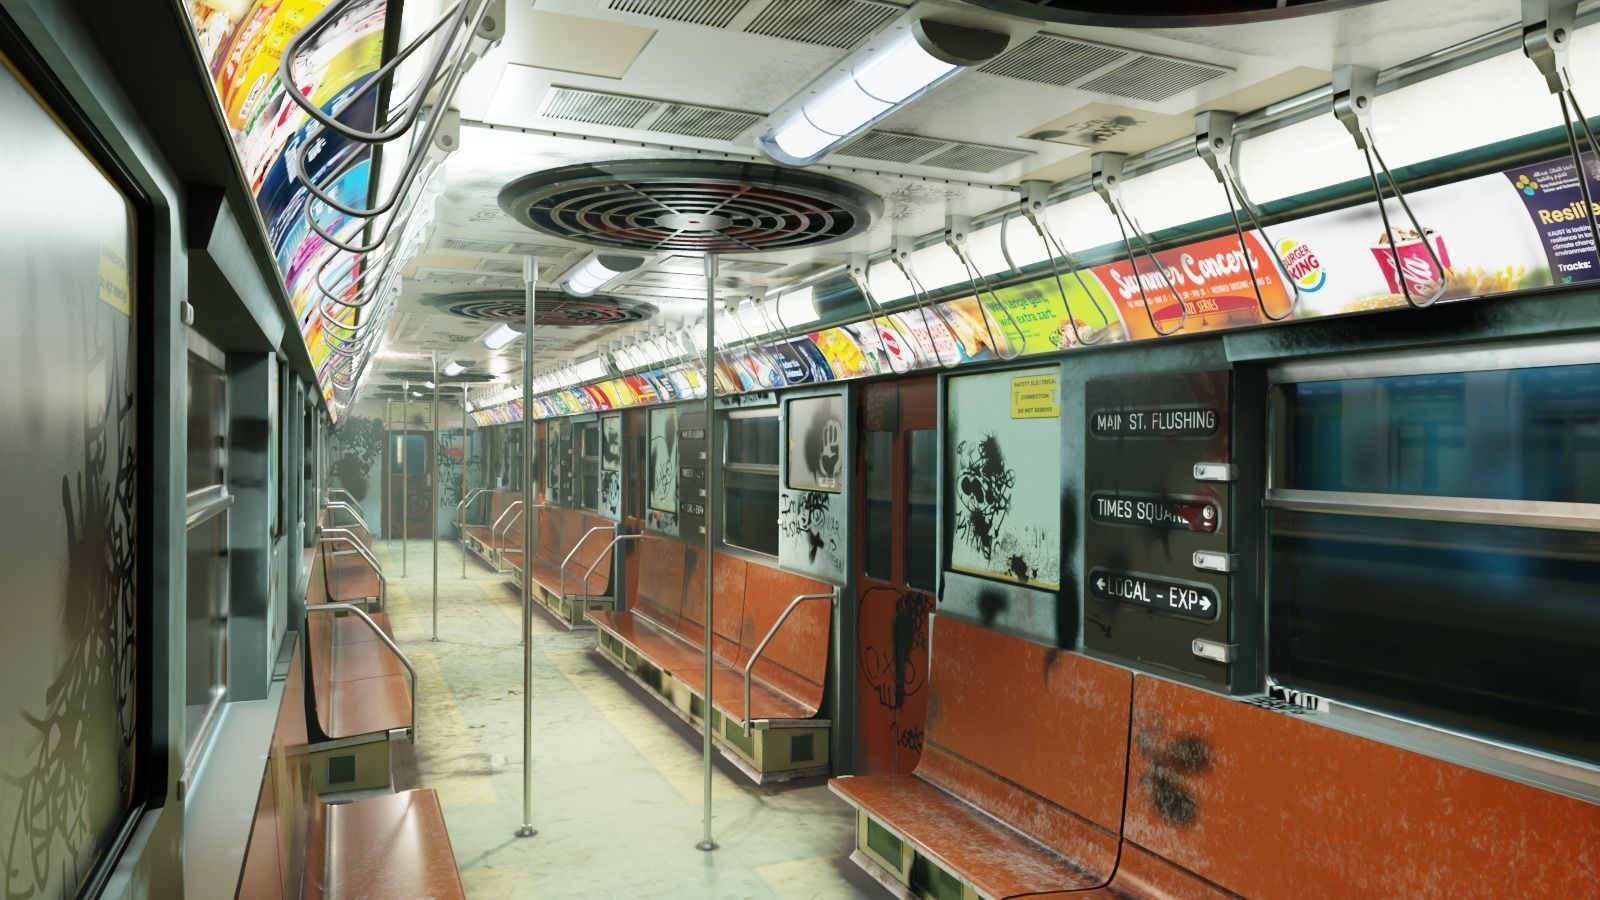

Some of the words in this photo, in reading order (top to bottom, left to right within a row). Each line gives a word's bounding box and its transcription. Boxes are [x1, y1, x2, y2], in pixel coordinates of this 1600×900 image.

[1574, 238, 1595, 248] chang
[1283, 244, 1311, 268] BURGER
[1557, 261, 1592, 272] Tracks:
[1109, 266, 1185, 300] Summer
[1179, 241, 1259, 285] Concert
[1287, 255, 1320, 280] KING
[1129, 413, 1147, 430] ST.
[1151, 410, 1215, 430] FLUSHING
[1097, 498, 1132, 519] TIMES
[1107, 577, 1151, 603] LOCAL
[1169, 585, 1199, 611] EXP
